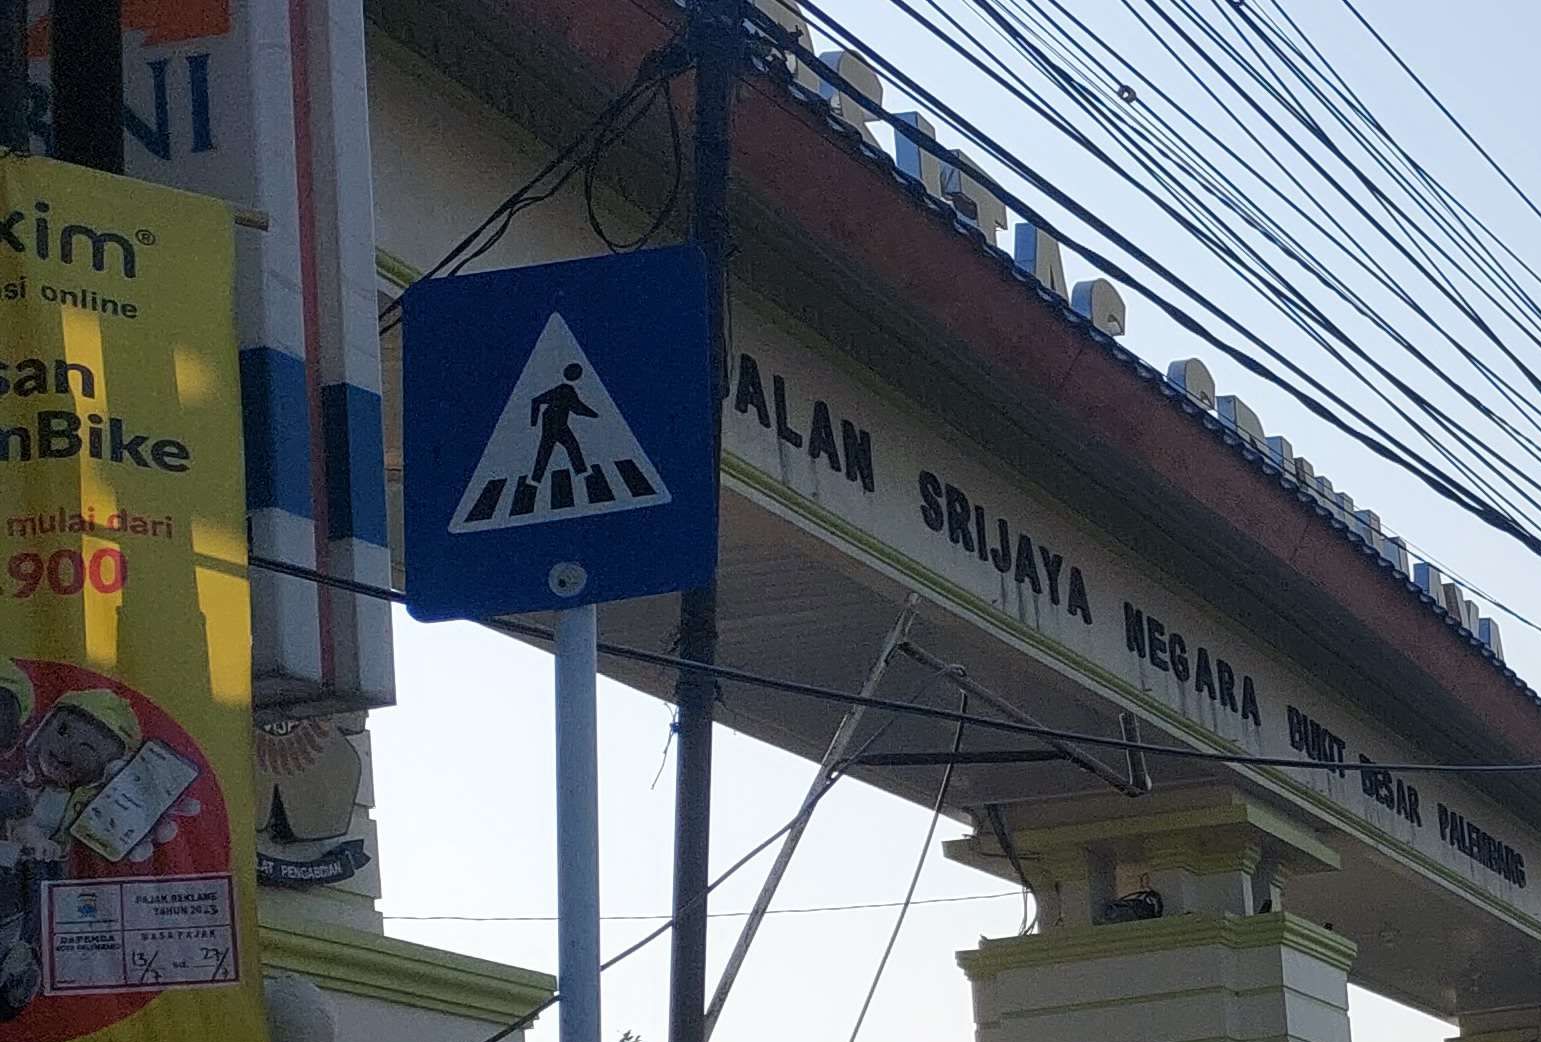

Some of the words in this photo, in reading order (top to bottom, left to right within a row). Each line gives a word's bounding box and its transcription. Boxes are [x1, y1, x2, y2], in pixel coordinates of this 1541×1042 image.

[41, 284, 138, 319] online
[7, 506, 96, 538] mulai
[107, 508, 175, 540] dari
[722, 350, 875, 493] ALAN
[918, 469, 1093, 625] SRIJAYA
[1123, 601, 1262, 727] NEGARA
[1287, 705, 1346, 779] BUKIT
[1358, 753, 1423, 828] BESAR
[1437, 802, 1527, 889] PALEMBANG
